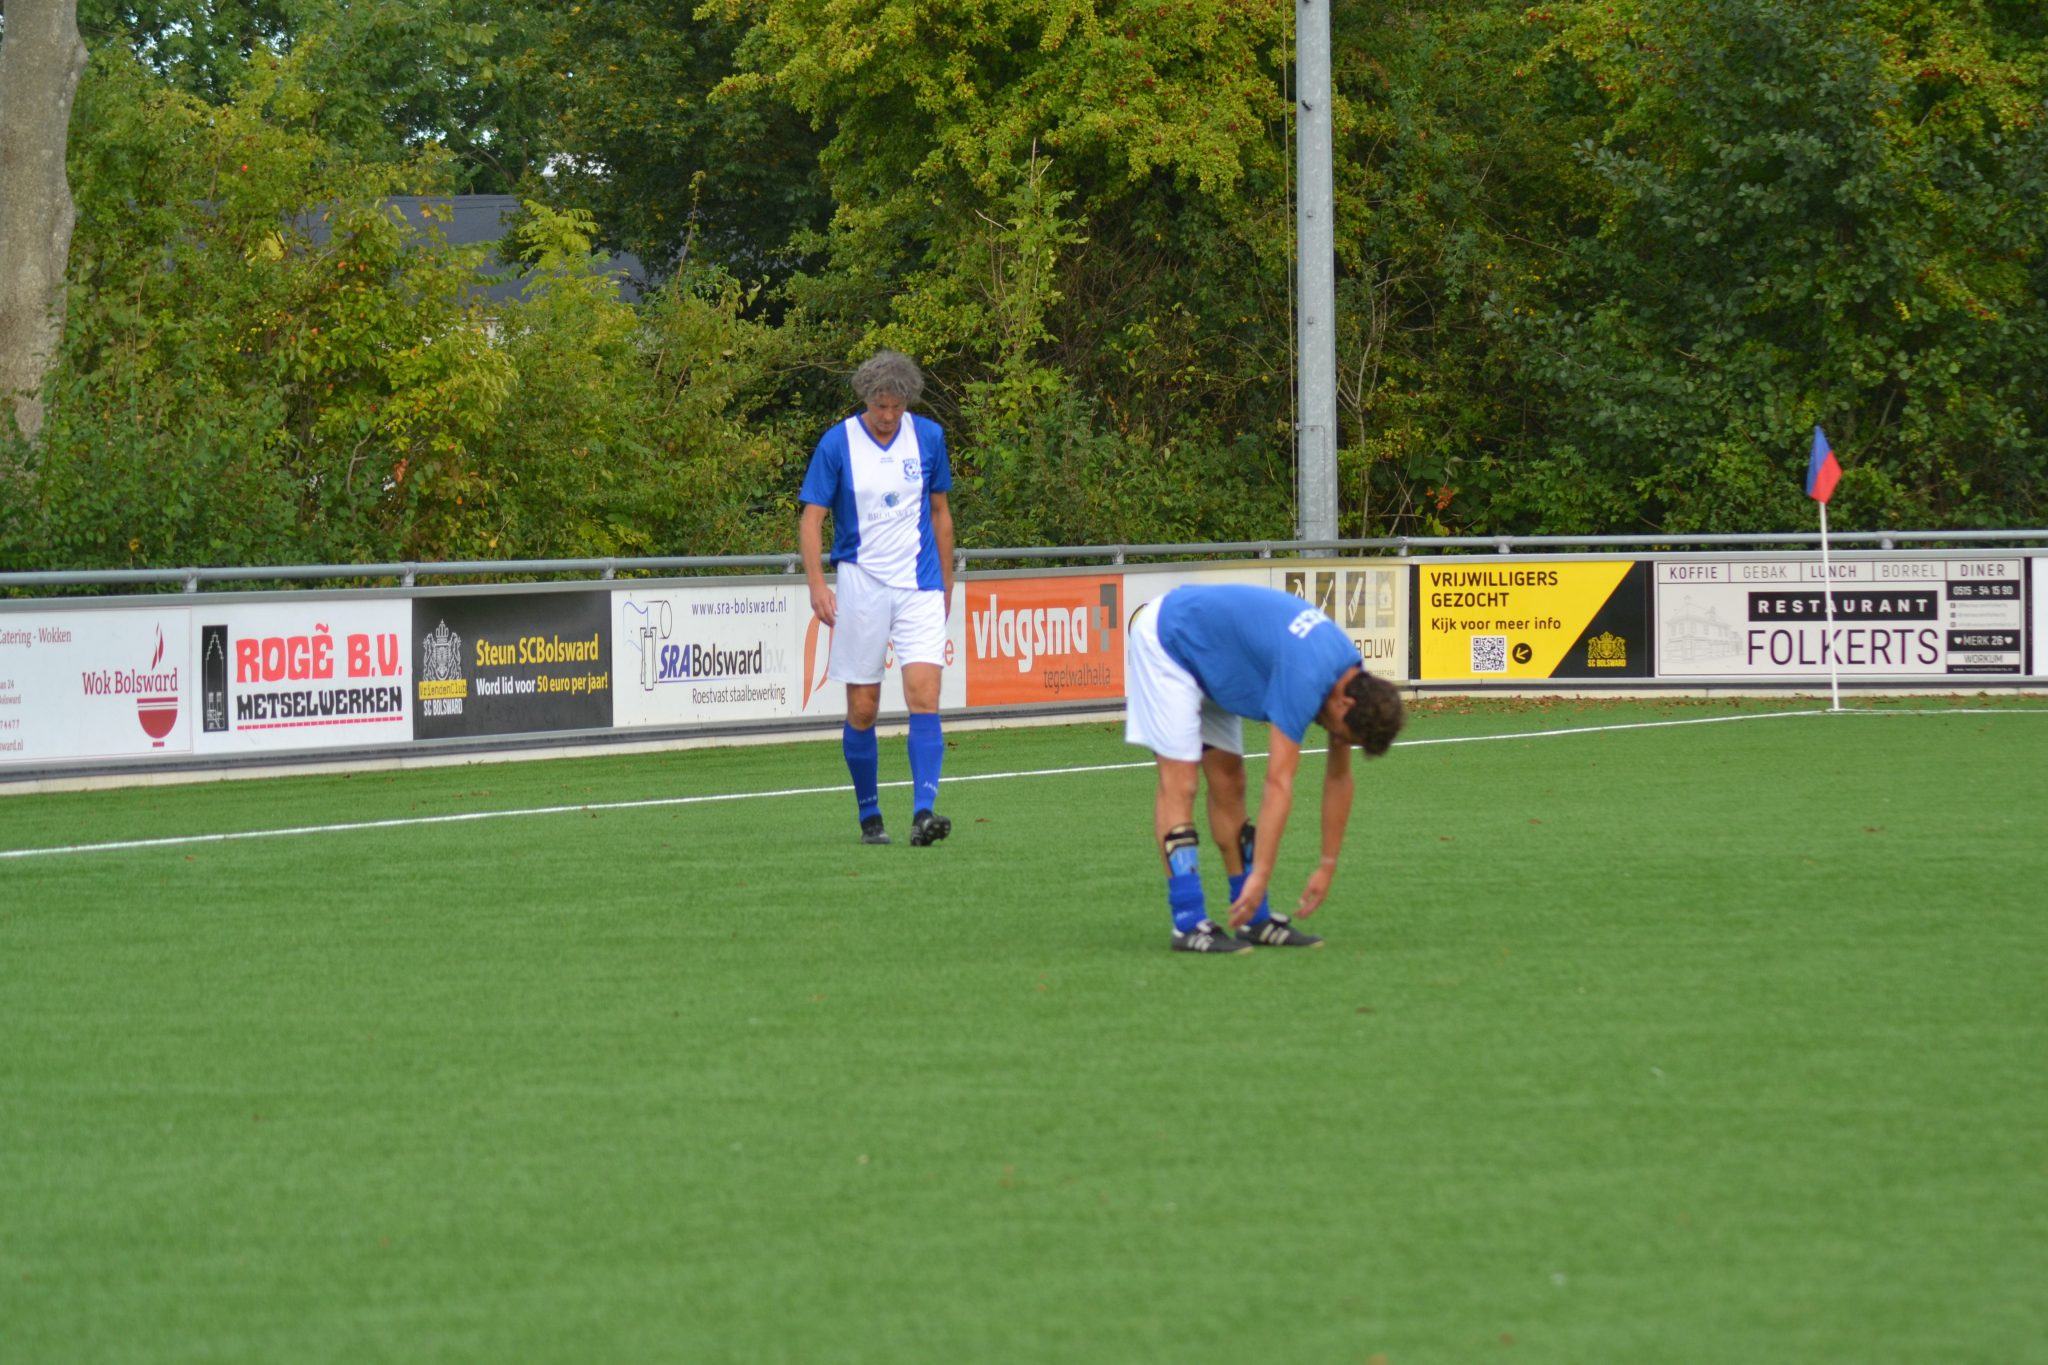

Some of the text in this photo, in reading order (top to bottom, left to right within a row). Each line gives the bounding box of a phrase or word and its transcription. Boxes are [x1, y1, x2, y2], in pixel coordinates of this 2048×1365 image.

[1669, 566, 1718, 580] KOFFIE
[1743, 565, 1788, 579] GEBAK
[1810, 565, 1857, 578] LUNCH
[1882, 564, 1937, 578] BORREL
[1960, 563, 2006, 577] DINER
[1430, 571, 1559, 587] VRIJWILLIGERS
[691, 596, 787, 616] www.sra-bolsward.nl
[1431, 592, 1510, 608] GEZOCHT
[1757, 598, 1928, 614] RESTAURANT
[972, 593, 1088, 673] vlagsma
[1431, 617, 1561, 633] Kijk voor meer info
[39, 627, 72, 643] Wokken
[476, 632, 599, 667] Steun SCBolsward
[1747, 628, 1939, 666] FOLKERTS
[347, 633, 402, 679] B.V.
[82, 667, 178, 695] Wok Bolsward
[476, 671, 609, 696] Word lid voor 50 euro per jaar!
[1043, 662, 1111, 694] tegelwalhalla
[692, 683, 786, 705] Roestvast staalbewerking
[236, 686, 403, 721] METSELWERKEN
[423, 699, 432, 716] SC
